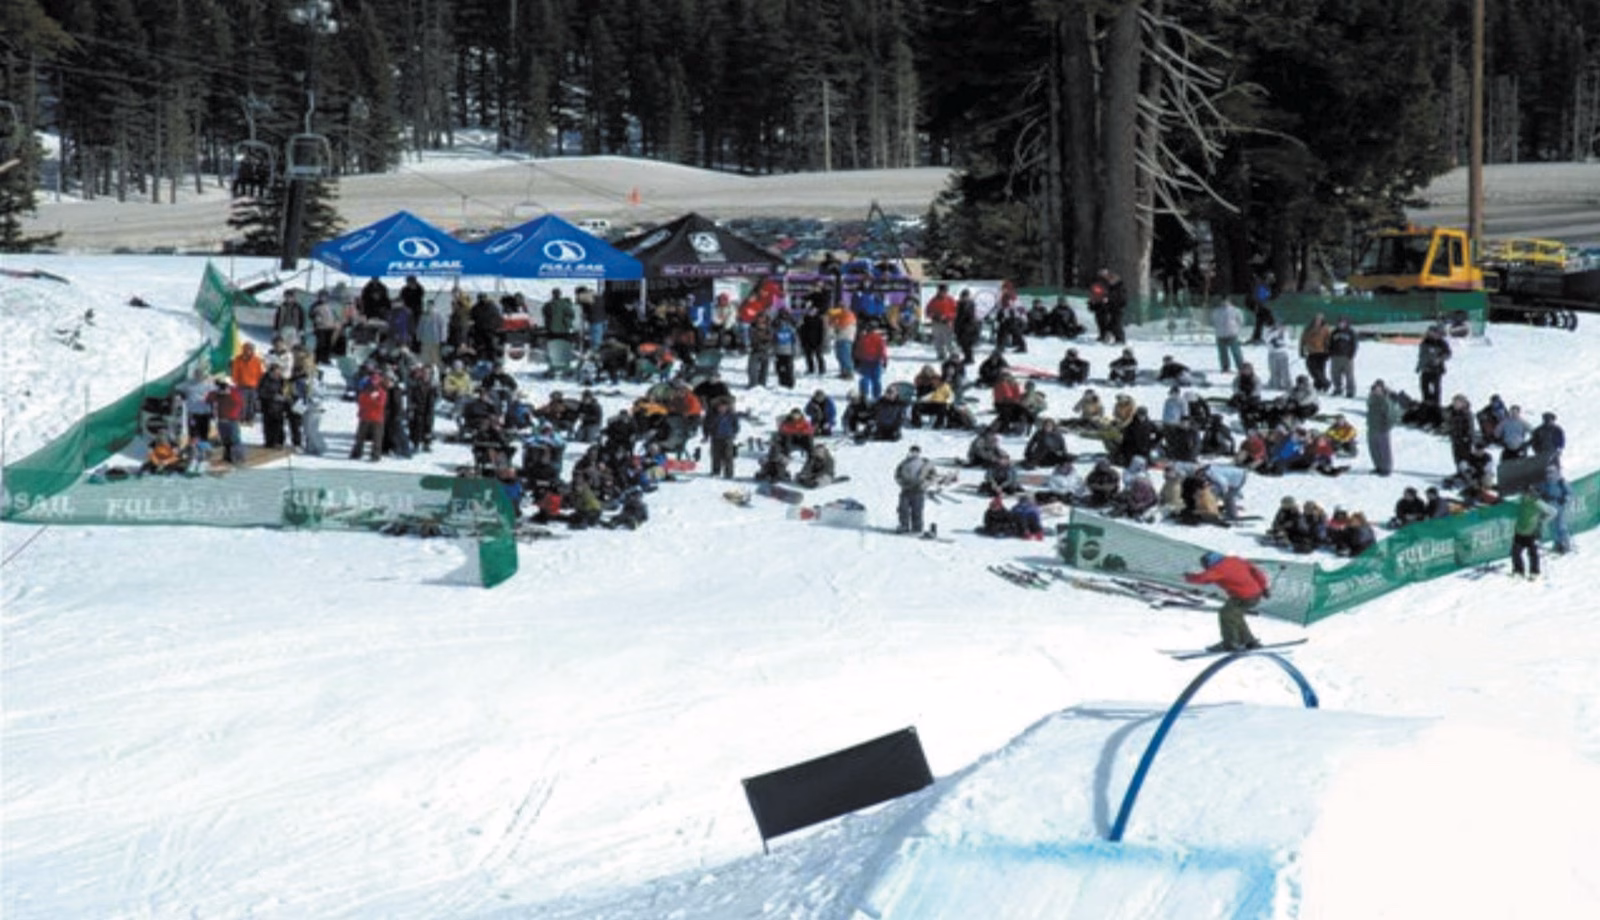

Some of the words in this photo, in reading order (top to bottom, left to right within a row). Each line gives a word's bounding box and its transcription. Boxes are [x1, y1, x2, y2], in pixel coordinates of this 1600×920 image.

[388, 261, 432, 271] FULL
[433, 260, 464, 269] SAIL
[13, 492, 76, 516] SAIL
[106, 497, 175, 518] FULL
